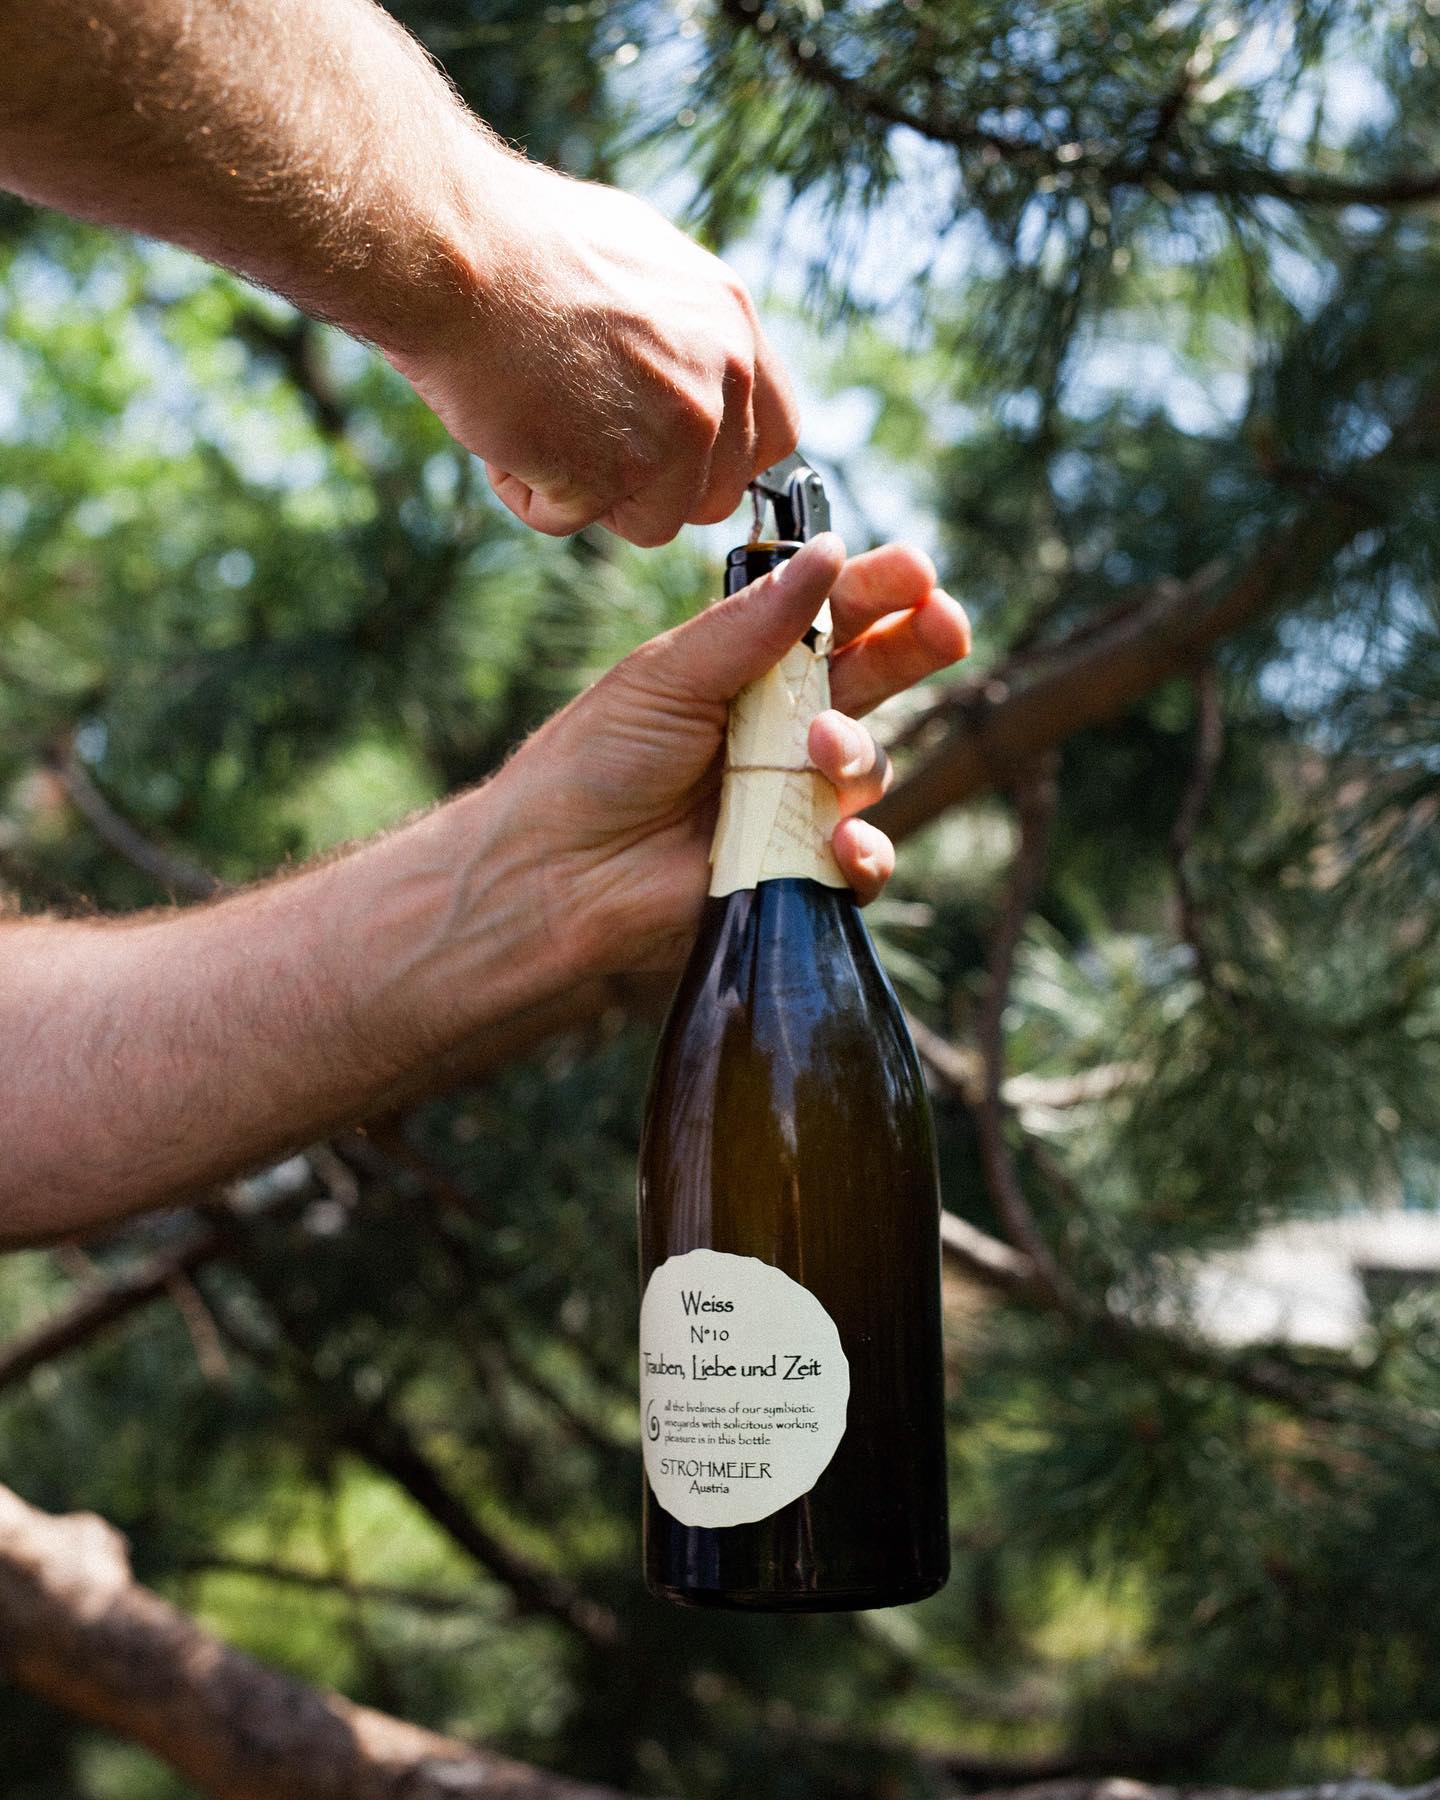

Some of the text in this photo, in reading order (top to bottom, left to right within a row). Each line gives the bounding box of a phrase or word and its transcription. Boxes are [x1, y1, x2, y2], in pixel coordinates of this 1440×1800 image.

[681, 1290, 734, 1316] Weiss
[643, 1351, 822, 1380] Trauben, Liebe und Zeit
[673, 1400, 684, 1412] the
[728, 1401, 740, 1414] of
[763, 1402, 815, 1419] symbiotic
[702, 1417, 721, 1428] with
[723, 1417, 773, 1430] solicitous
[776, 1417, 819, 1433] working
[664, 1430, 771, 1446] pleasure is in this bottle
[689, 1479, 729, 1495] Austria
